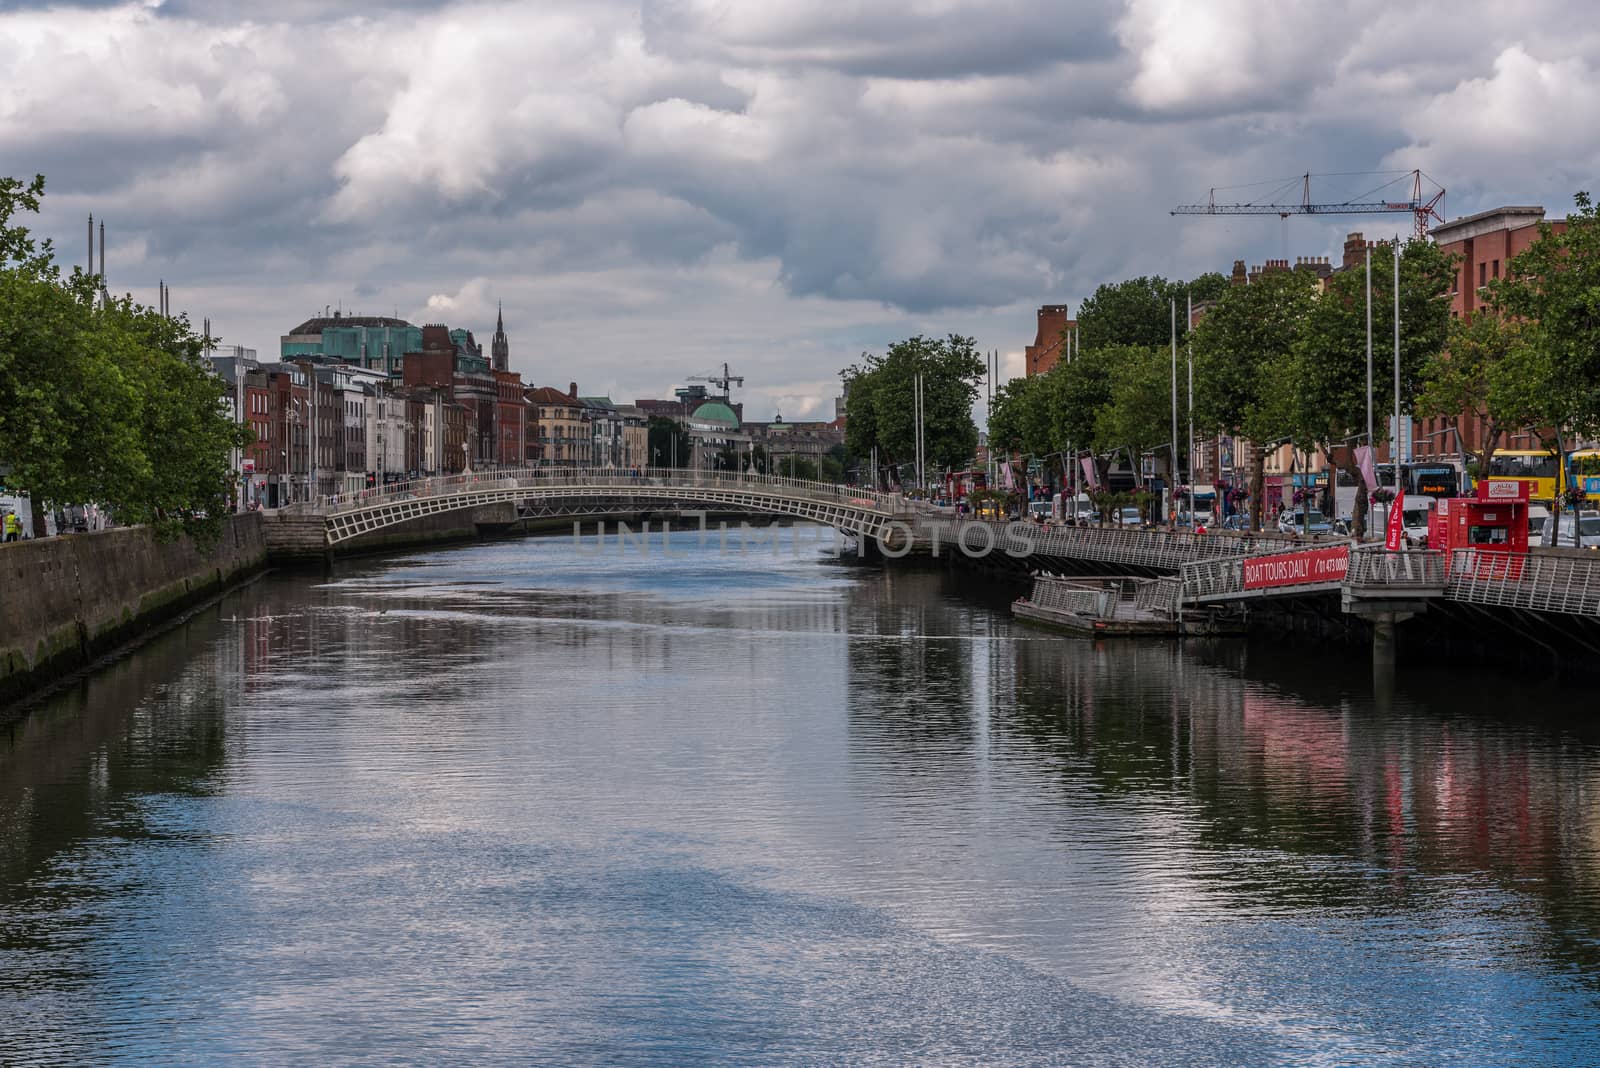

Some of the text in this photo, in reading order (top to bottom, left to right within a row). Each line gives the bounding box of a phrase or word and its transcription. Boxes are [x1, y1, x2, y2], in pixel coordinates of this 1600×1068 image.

[1389, 528, 1398, 547] Boat
[1246, 565, 1264, 583] BOAT
[1264, 561, 1288, 580] TOURS
[1289, 558, 1310, 578] DAILY
[1325, 558, 1335, 573] 473
